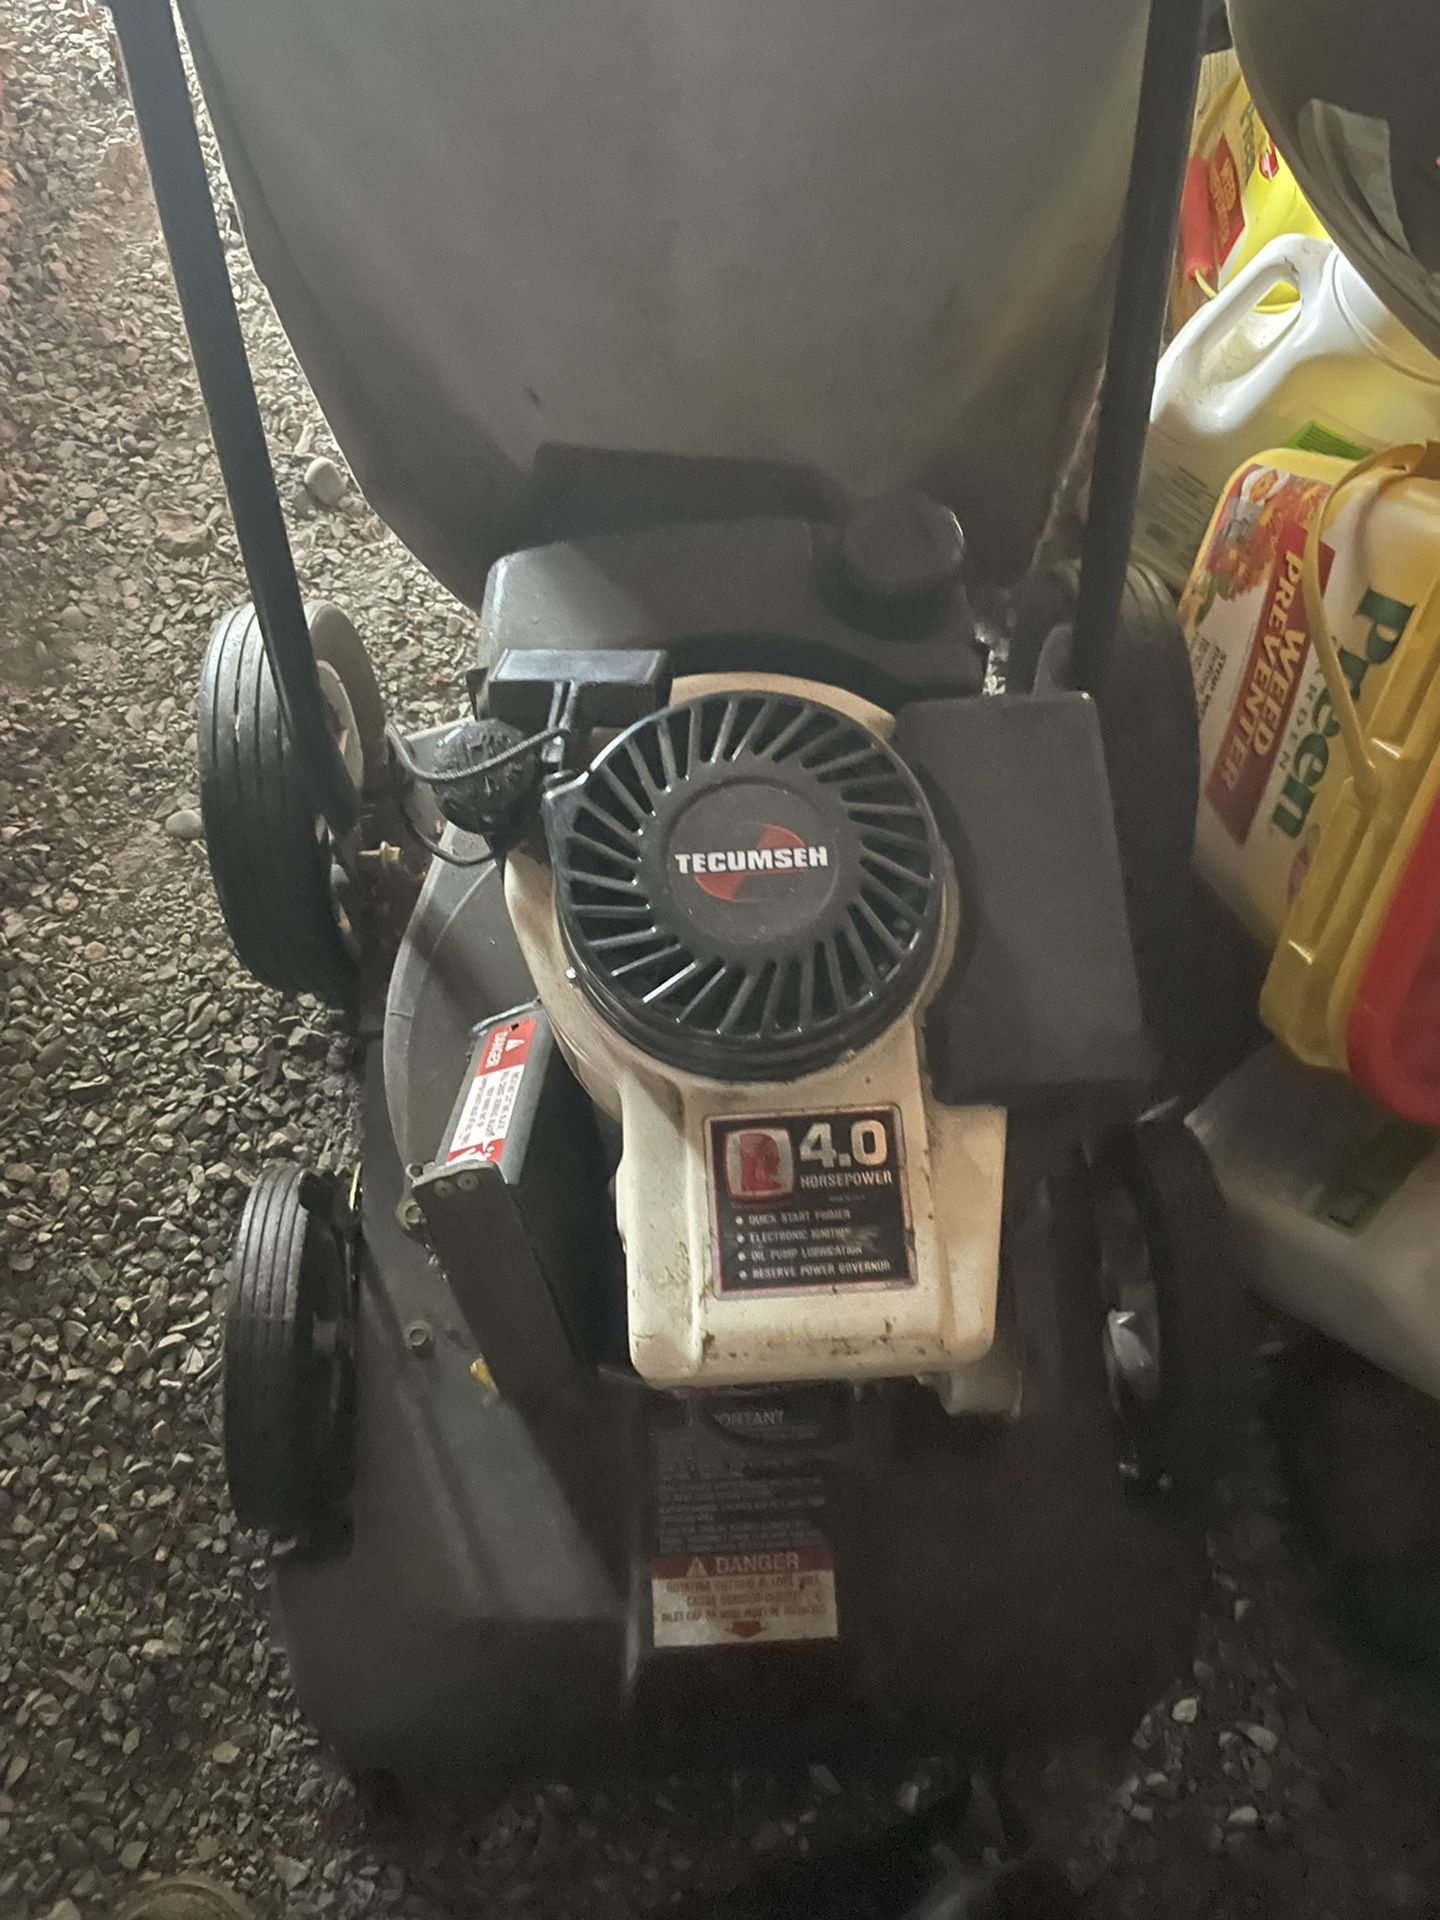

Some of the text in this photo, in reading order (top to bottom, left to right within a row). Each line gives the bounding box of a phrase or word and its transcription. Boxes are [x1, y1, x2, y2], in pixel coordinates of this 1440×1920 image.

[1253, 628, 1306, 756] WEED
[675, 846, 828, 874] TECUMSEH
[800, 1119, 888, 1168] 4.0
[801, 1170, 893, 1189] HORSEPOWER
[770, 1247, 798, 1261] PUMP
[752, 1258, 891, 1280] RESERVE POWER GOVERNOR
[715, 1552, 800, 1574] DANGER
